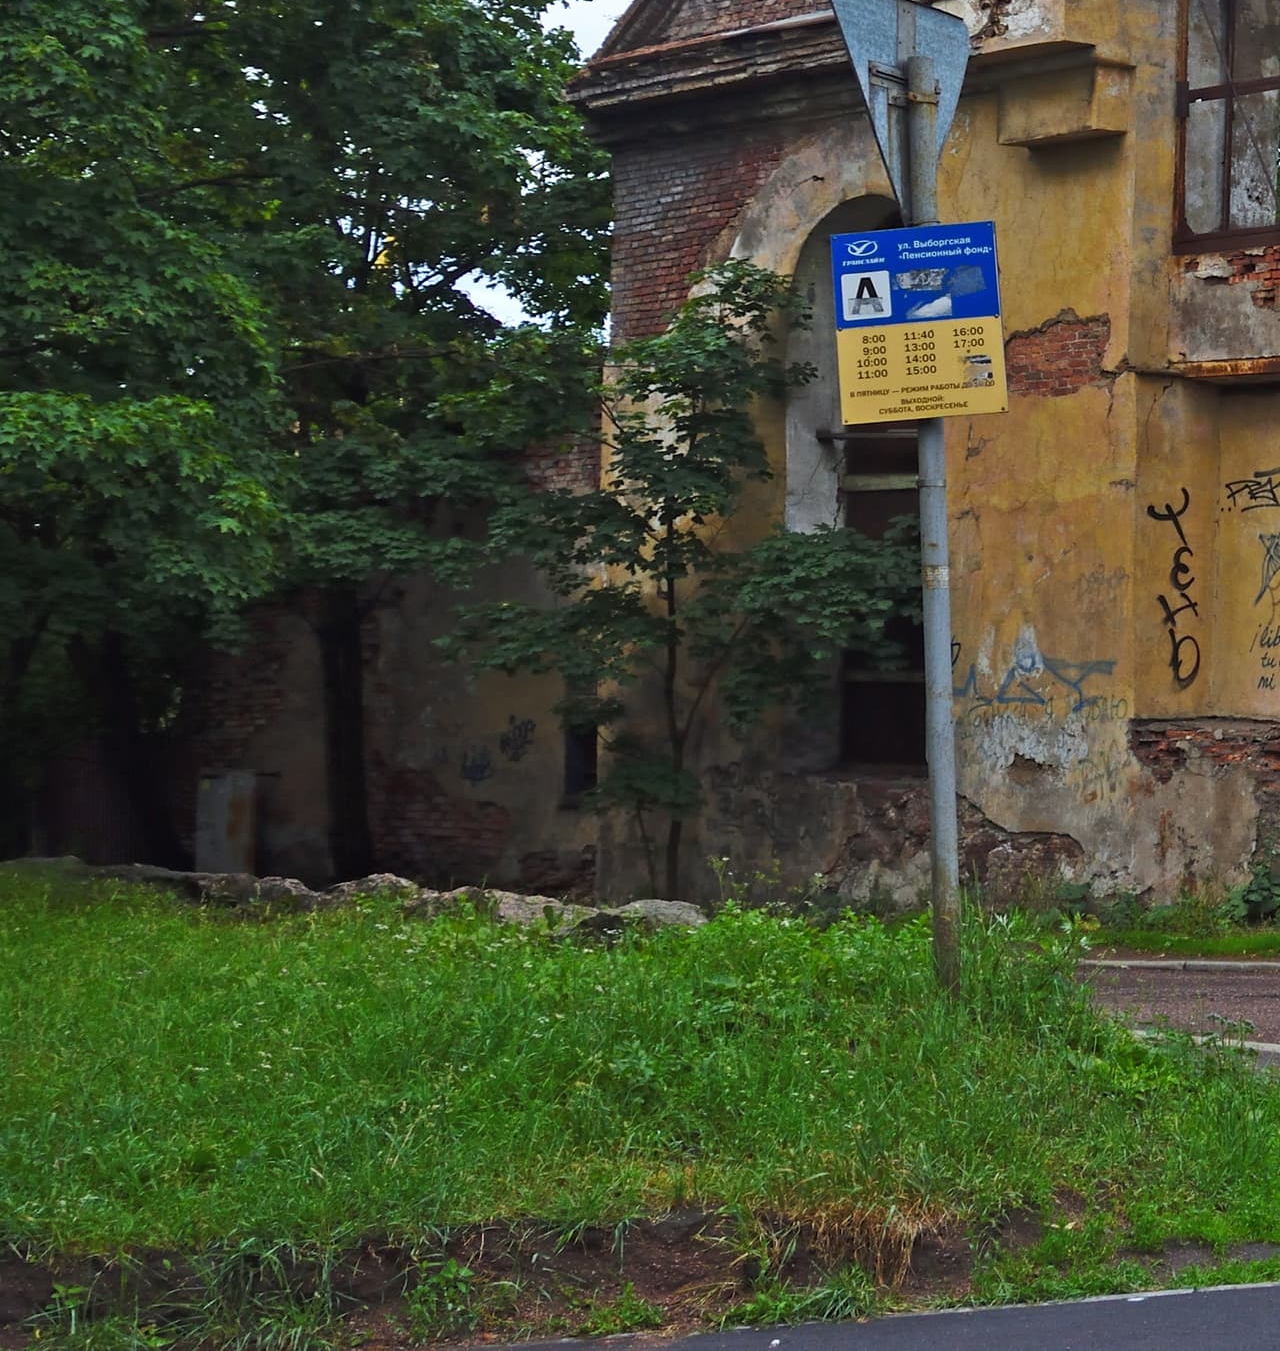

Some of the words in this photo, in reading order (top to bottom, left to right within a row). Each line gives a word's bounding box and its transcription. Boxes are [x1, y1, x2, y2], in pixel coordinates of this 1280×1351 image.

[897, 242, 911, 251] ул.
[913, 237, 971, 249] Выборгская
[899, 248, 962, 260] «Пенсионный
[862, 334, 886, 344] 8:00
[903, 329, 935, 341] 11:40
[952, 326, 984, 337] 16:00
[862, 346, 887, 356] 9:00
[904, 342, 936, 353] 13:00
[953, 338, 985, 349] 17:00
[856, 357, 888, 368] 10:00
[905, 353, 937, 364] 14:00
[857, 369, 888, 380] 11:00
[905, 365, 937, 376] 15:00
[856, 388, 890, 398] ПЯТНИЦУ
[901, 385, 929, 394] РЕЖИМ
[930, 382, 960, 391] РАБОТЫ
[900, 395, 945, 405] ВЫХОДНОЙ:
[878, 405, 914, 415] СУББОТА,
[915, 401, 968, 412] ВОСКРЕСЕНЬЕ
[1261, 652, 1277, 668] tu
[1257, 673, 1275, 689] mi
